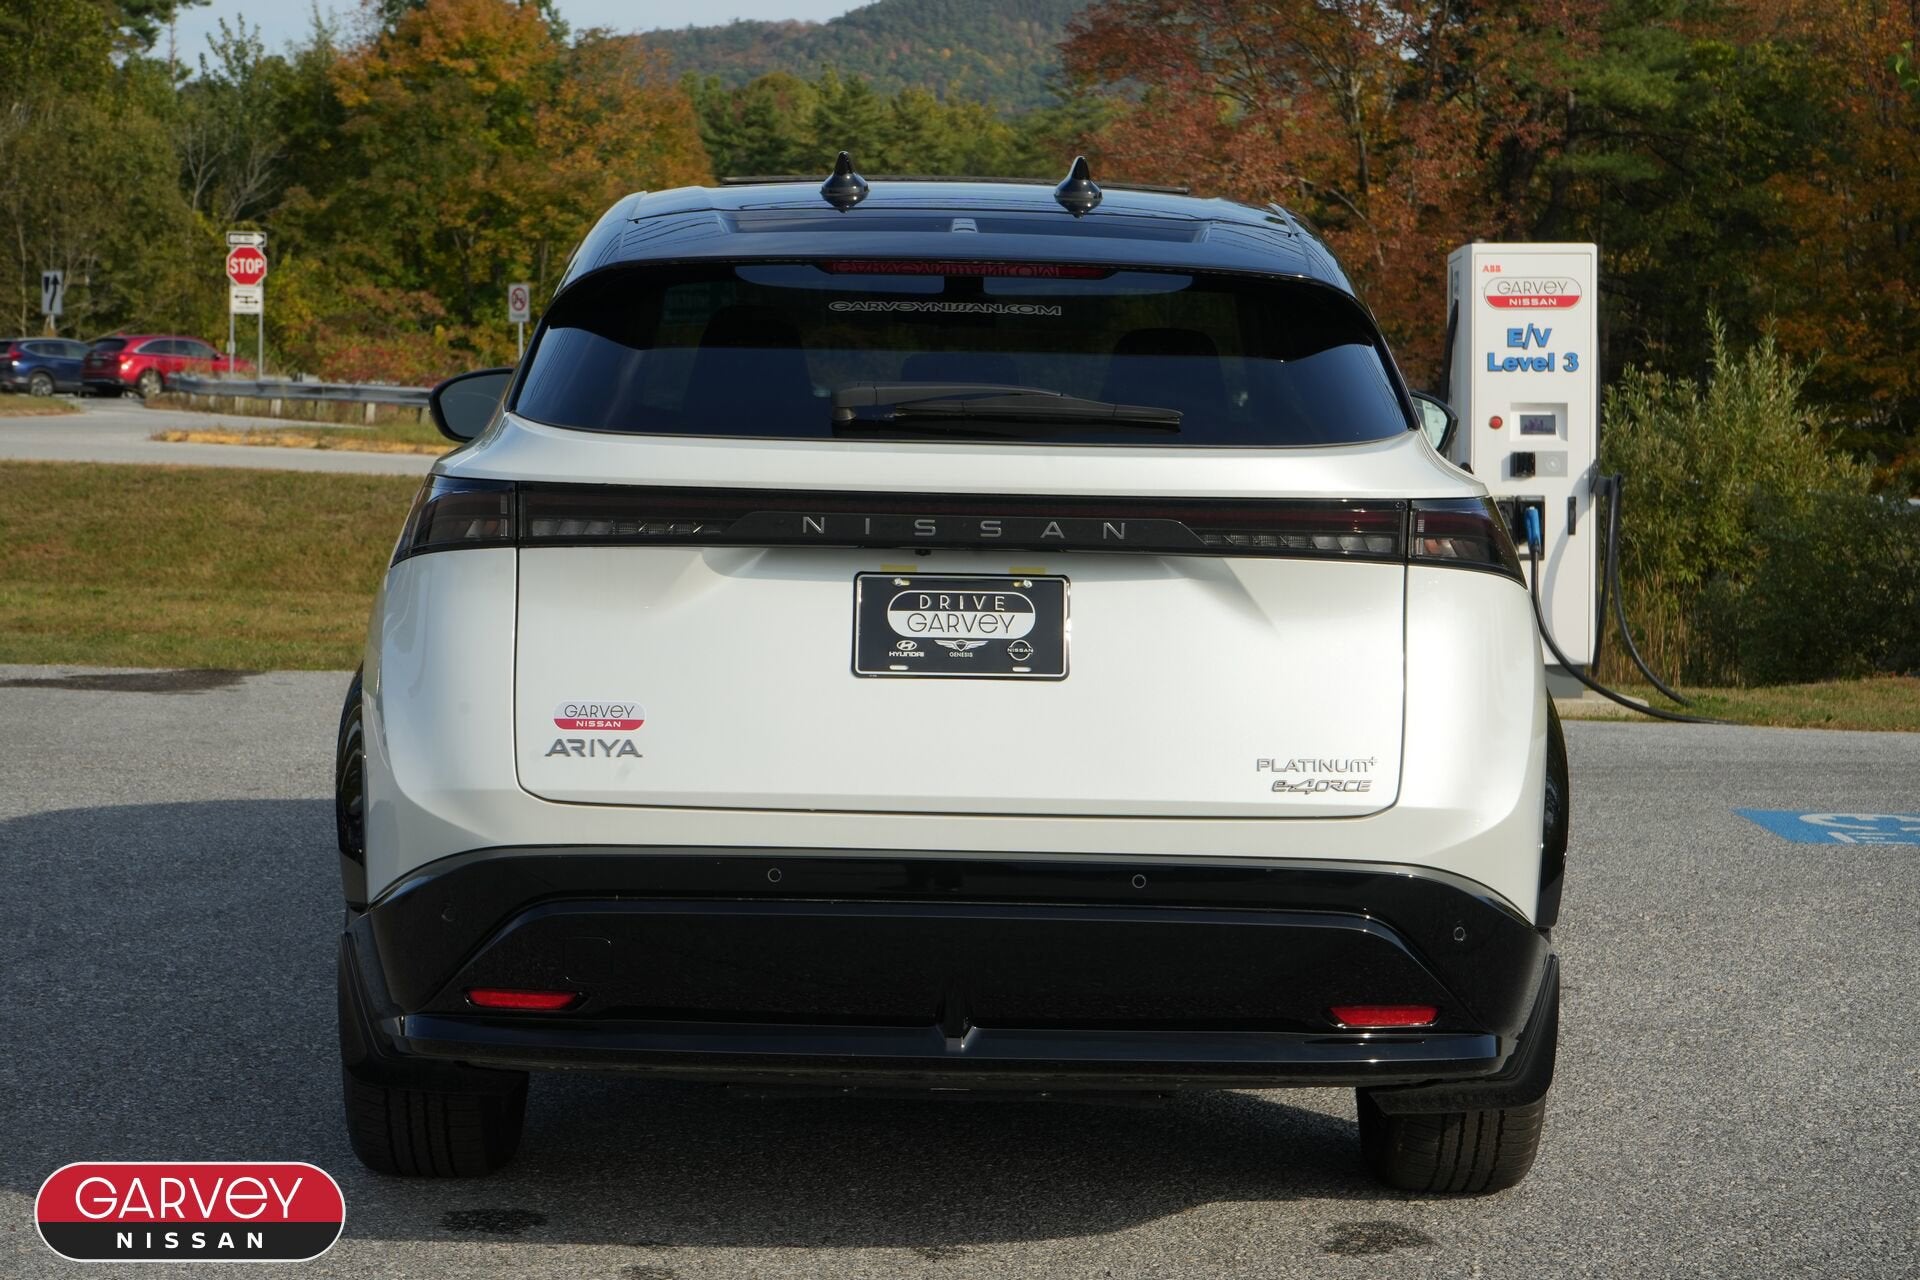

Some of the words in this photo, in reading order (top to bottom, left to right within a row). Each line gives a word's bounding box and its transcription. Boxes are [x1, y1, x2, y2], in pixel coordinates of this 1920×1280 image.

[230, 257, 263, 274] STOP
[1482, 264, 1502, 273] ABB
[1509, 298, 1557, 306] NISSAN
[1507, 323, 1552, 350] E/V
[1487, 352, 1555, 373] Level
[1562, 352, 1580, 373] 3
[802, 516, 1126, 540] NISSAN
[919, 594, 1006, 612] DRIVE
[575, 720, 622, 728] NISSAN
[544, 738, 643, 758] ARIYA
